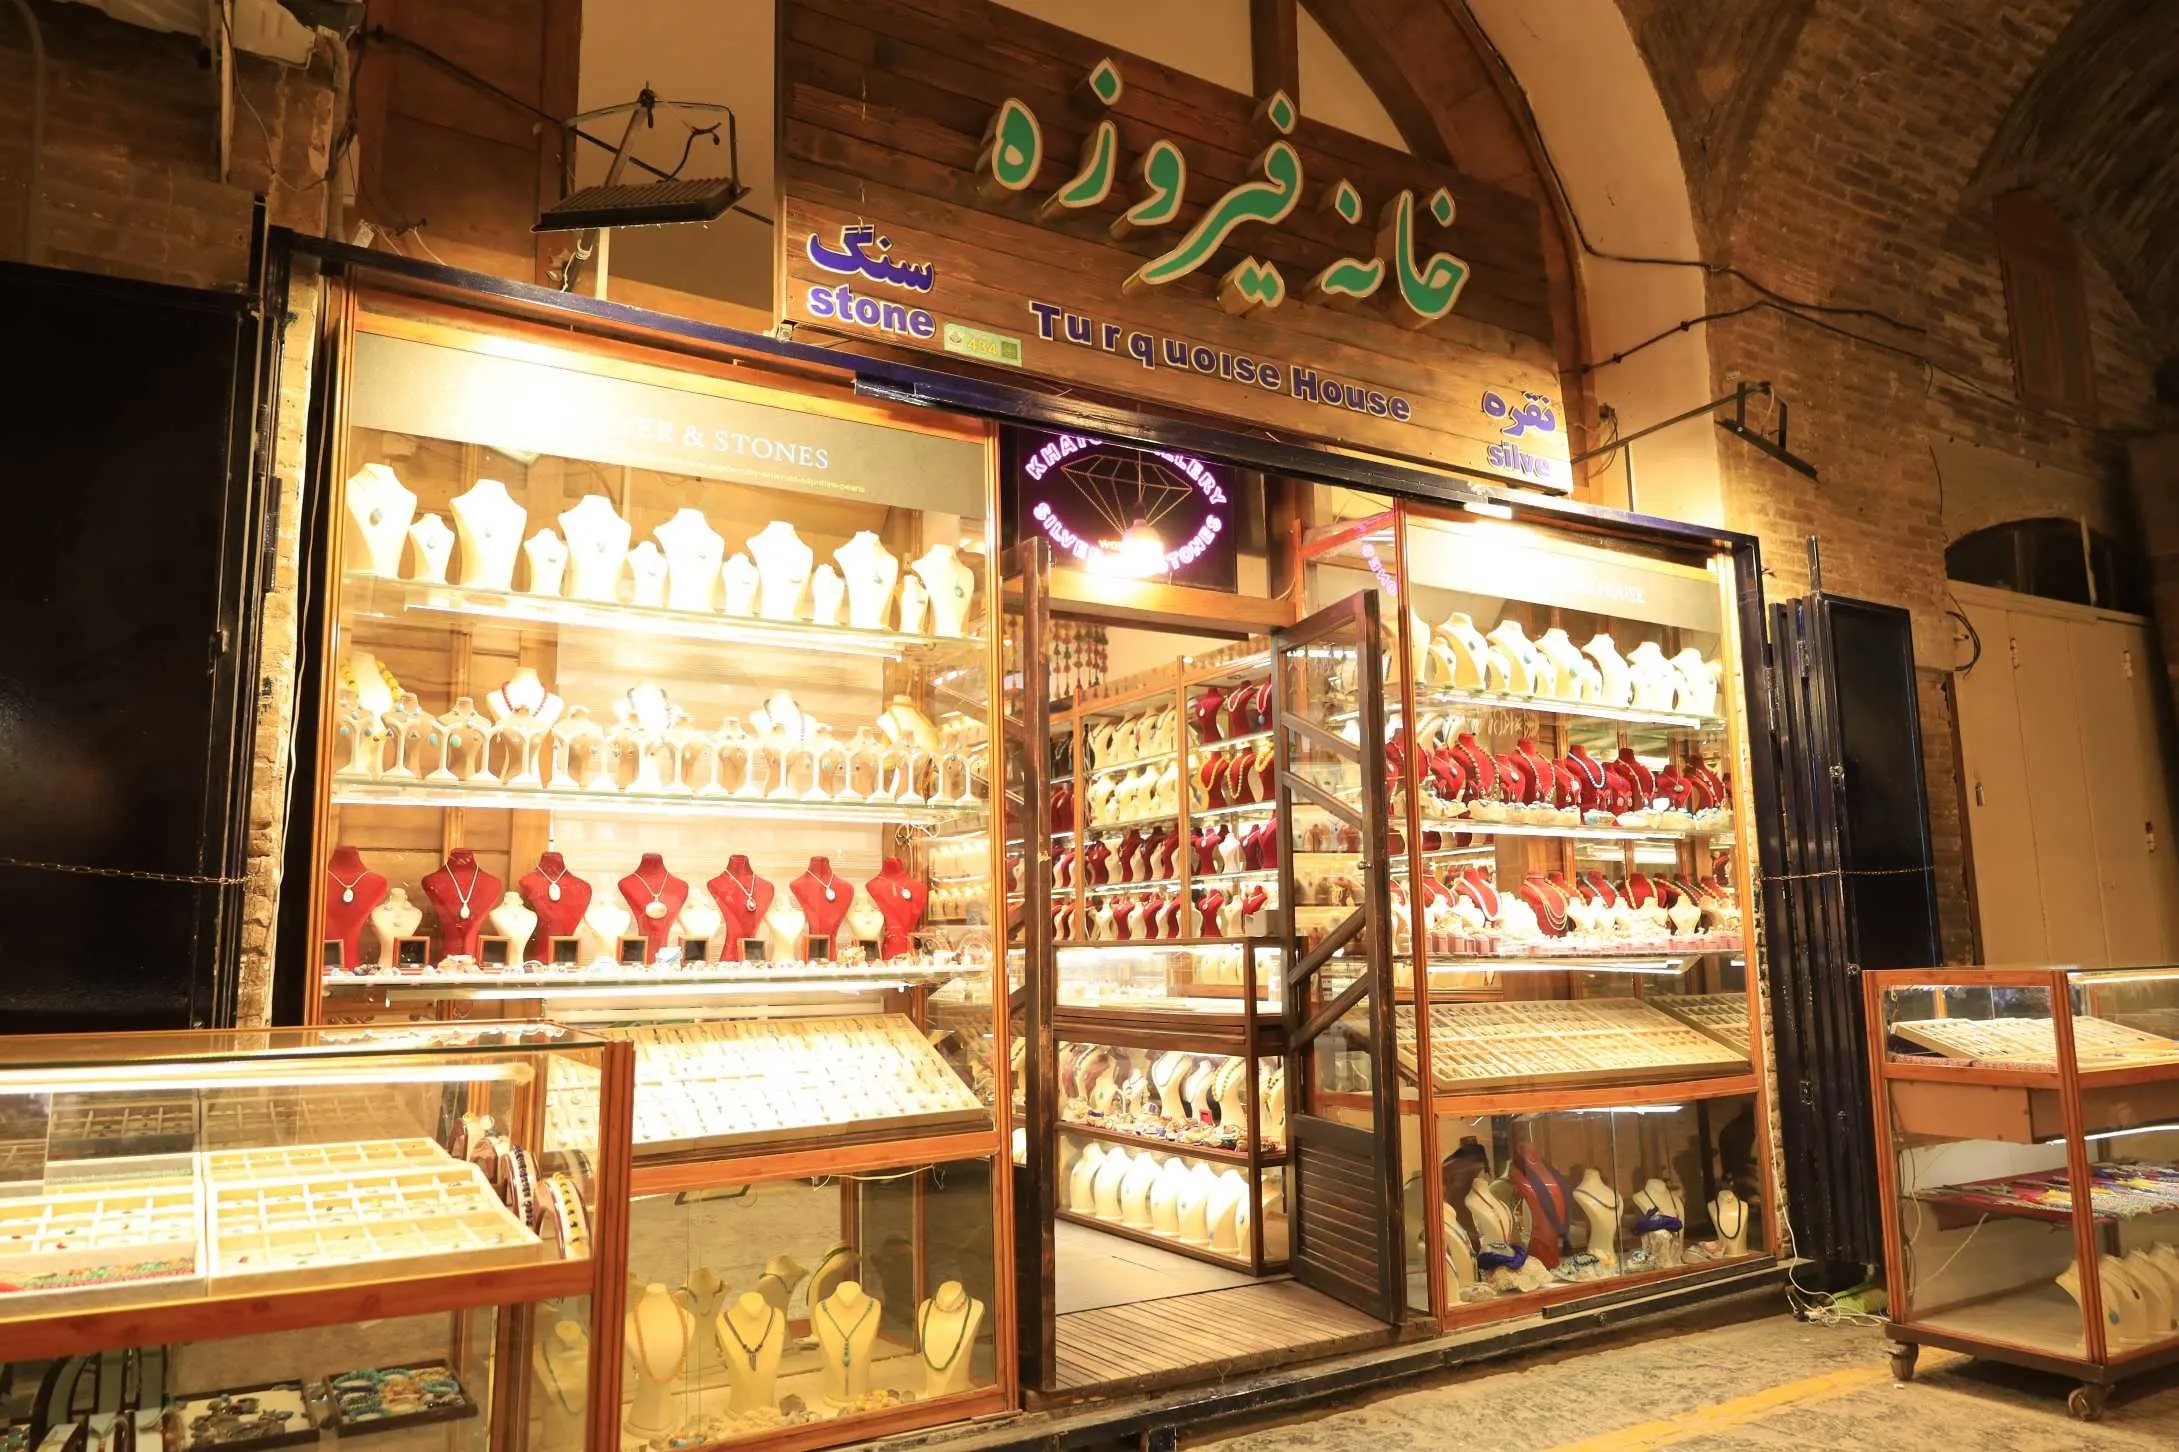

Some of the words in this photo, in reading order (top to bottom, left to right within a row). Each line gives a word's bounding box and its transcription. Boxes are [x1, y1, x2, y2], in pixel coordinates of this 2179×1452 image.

[992, 57, 1304, 308] فیروزه
[806, 224, 936, 294] سنگ
[1322, 178, 1471, 320] خانه
[807, 284, 937, 340] stone
[1028, 300, 1282, 389] Turquoise
[1290, 365, 1412, 422] House
[681, 424, 705, 448] &
[713, 429, 830, 470] STONES
[1482, 391, 1557, 438] نقره
